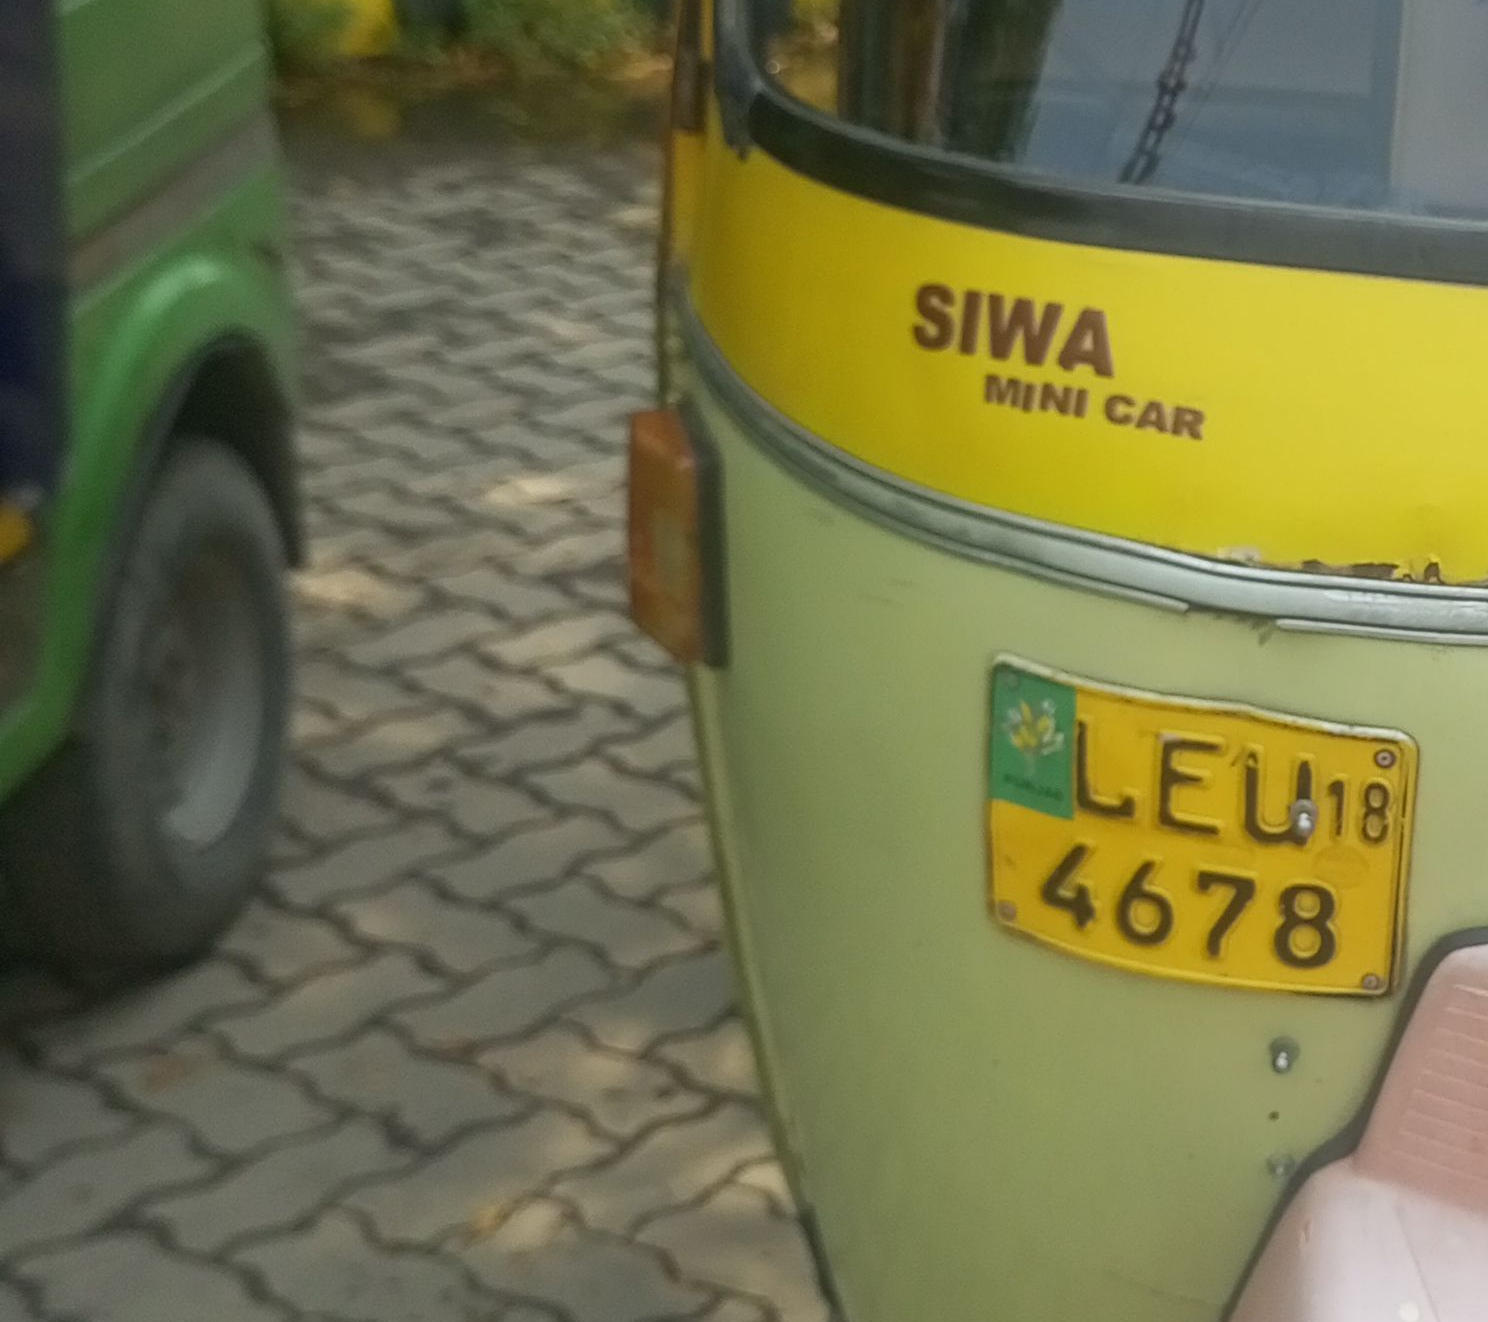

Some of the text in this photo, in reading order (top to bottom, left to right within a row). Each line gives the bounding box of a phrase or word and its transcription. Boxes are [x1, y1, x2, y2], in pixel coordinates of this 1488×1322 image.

[912, 282, 1114, 378] SIWA
[984, 374, 1206, 441] MINI CAR
[1076, 720, 1390, 846] LEU 18
[1041, 843, 1336, 970] 4678
